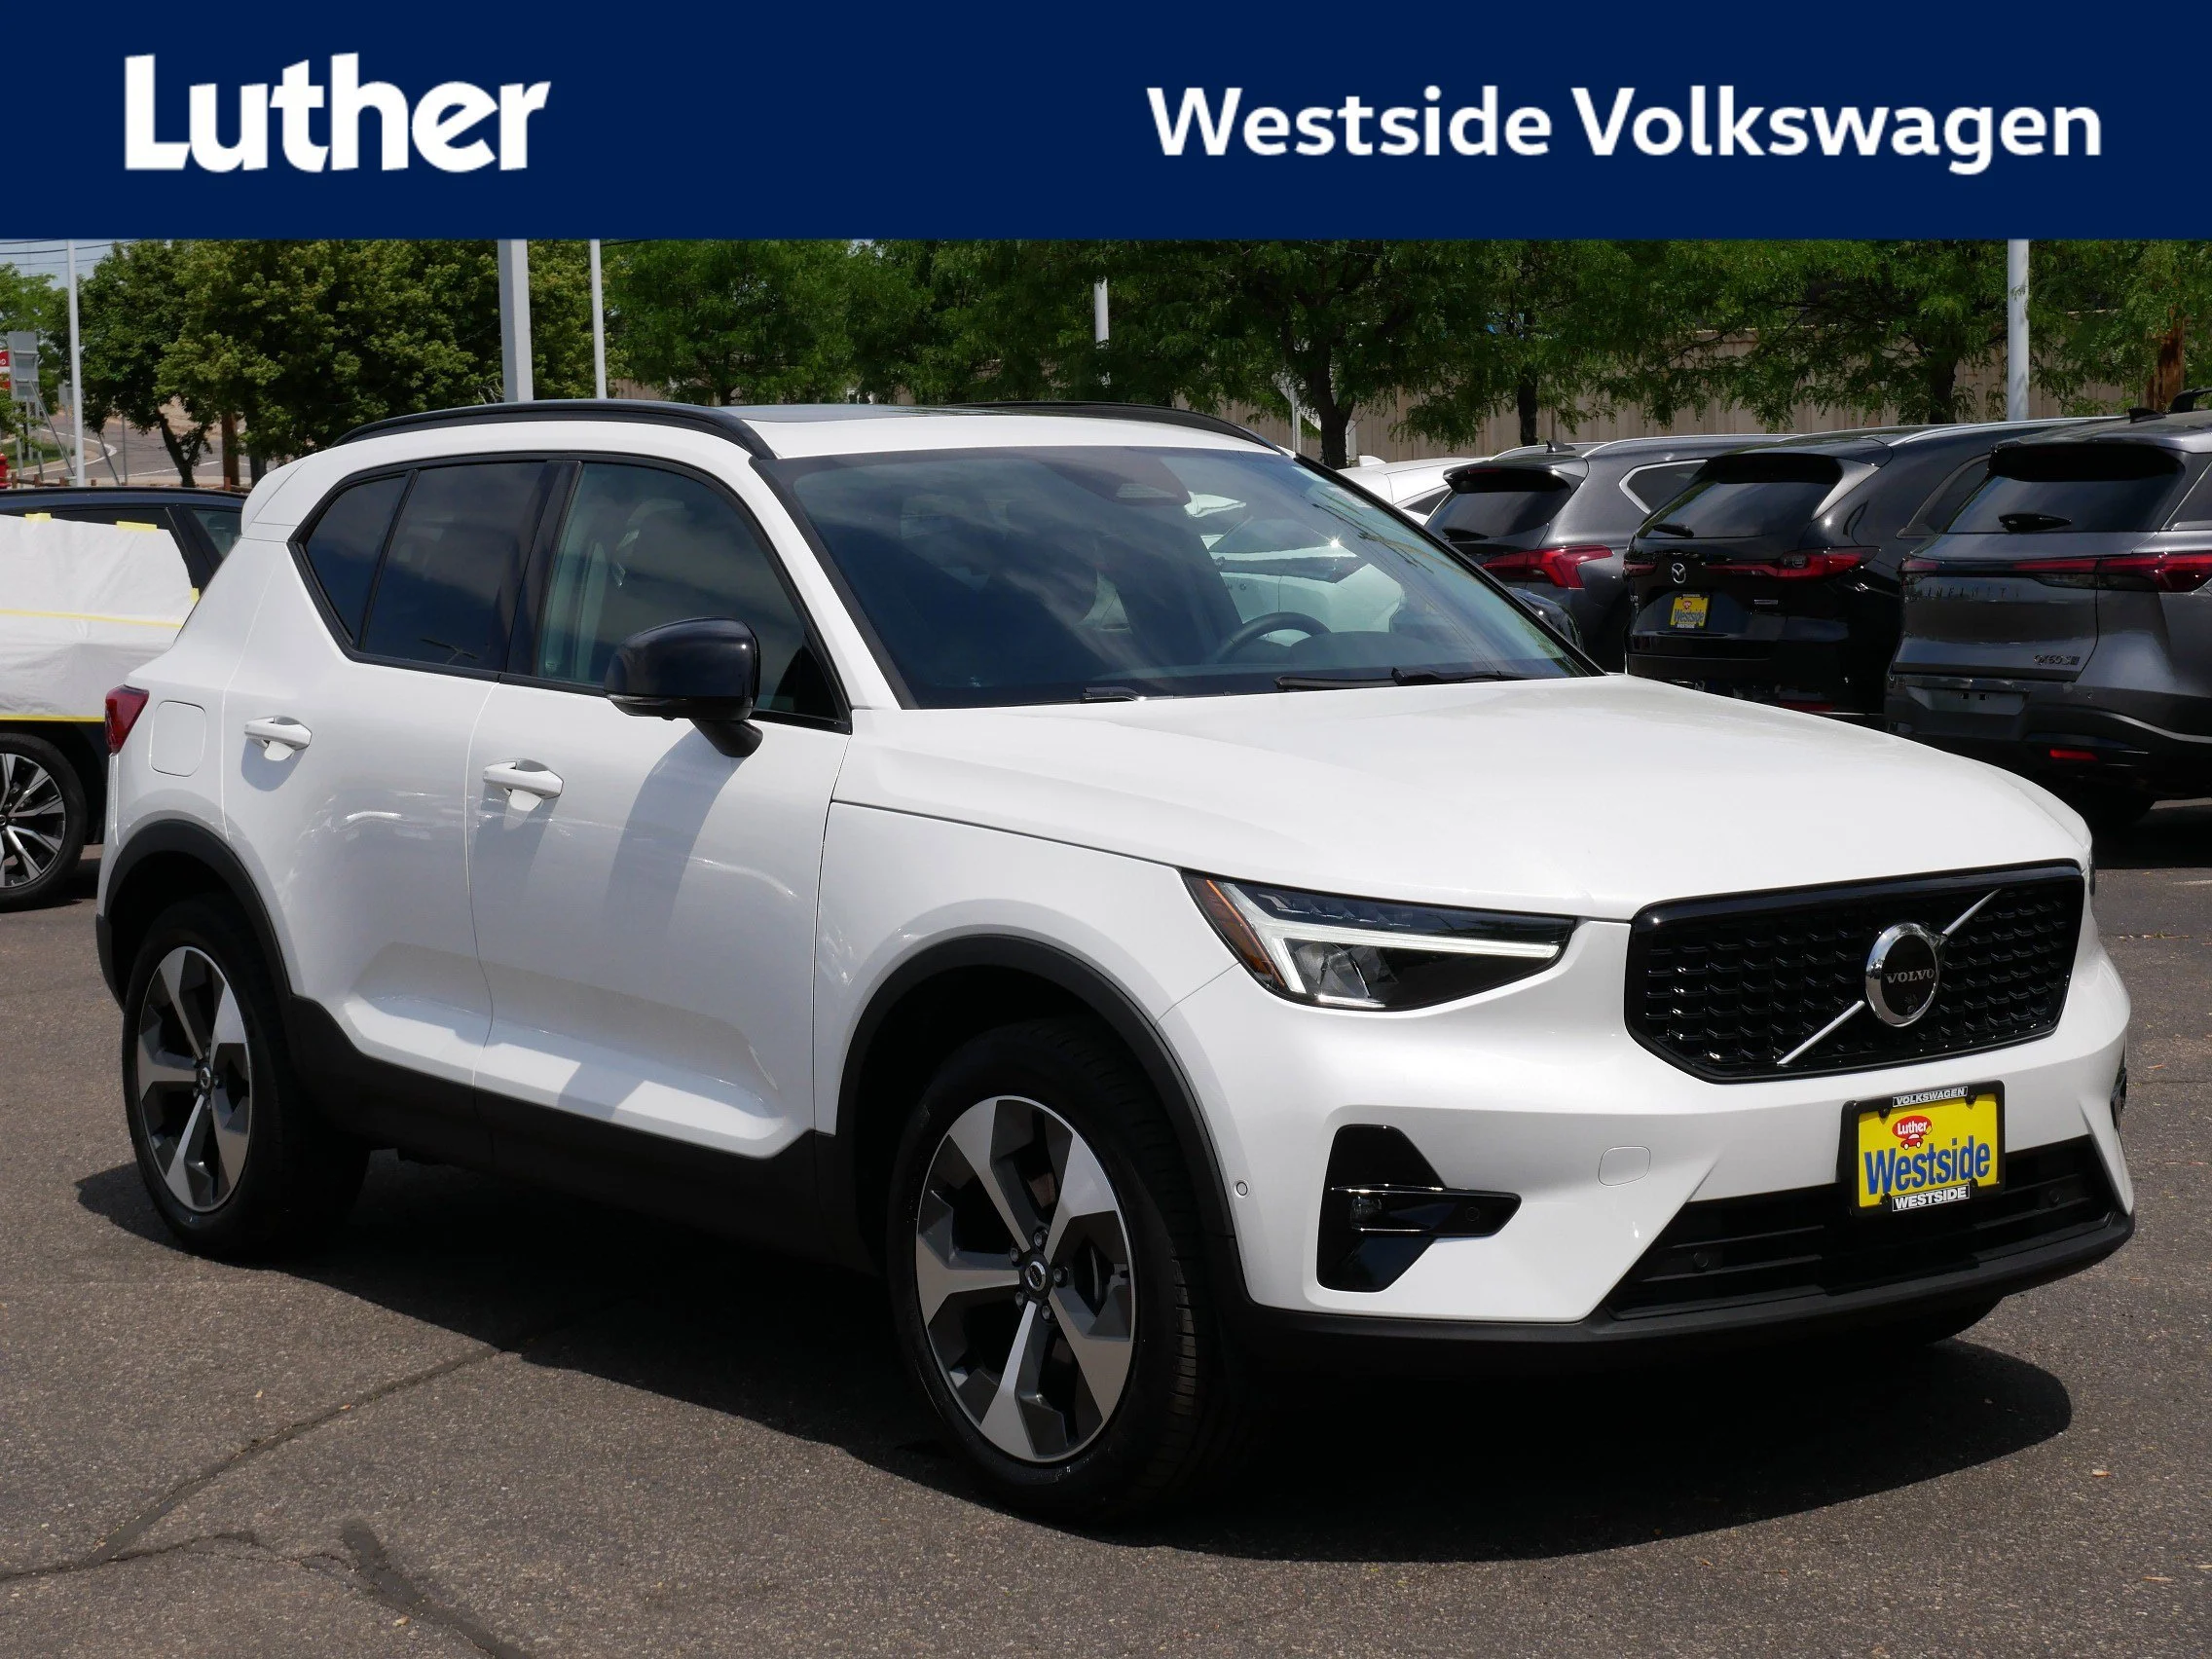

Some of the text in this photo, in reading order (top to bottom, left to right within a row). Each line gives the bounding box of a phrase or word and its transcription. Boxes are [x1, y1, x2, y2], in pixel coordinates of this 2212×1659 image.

[1885, 968, 1936, 983] VOLVO
[1895, 1088, 1966, 1106] VOLKSWAGEN
[1897, 1120, 1928, 1136] Luther
[1863, 1135, 1991, 1196] Westside
[1894, 1186, 1968, 1210] WESTSIDE
